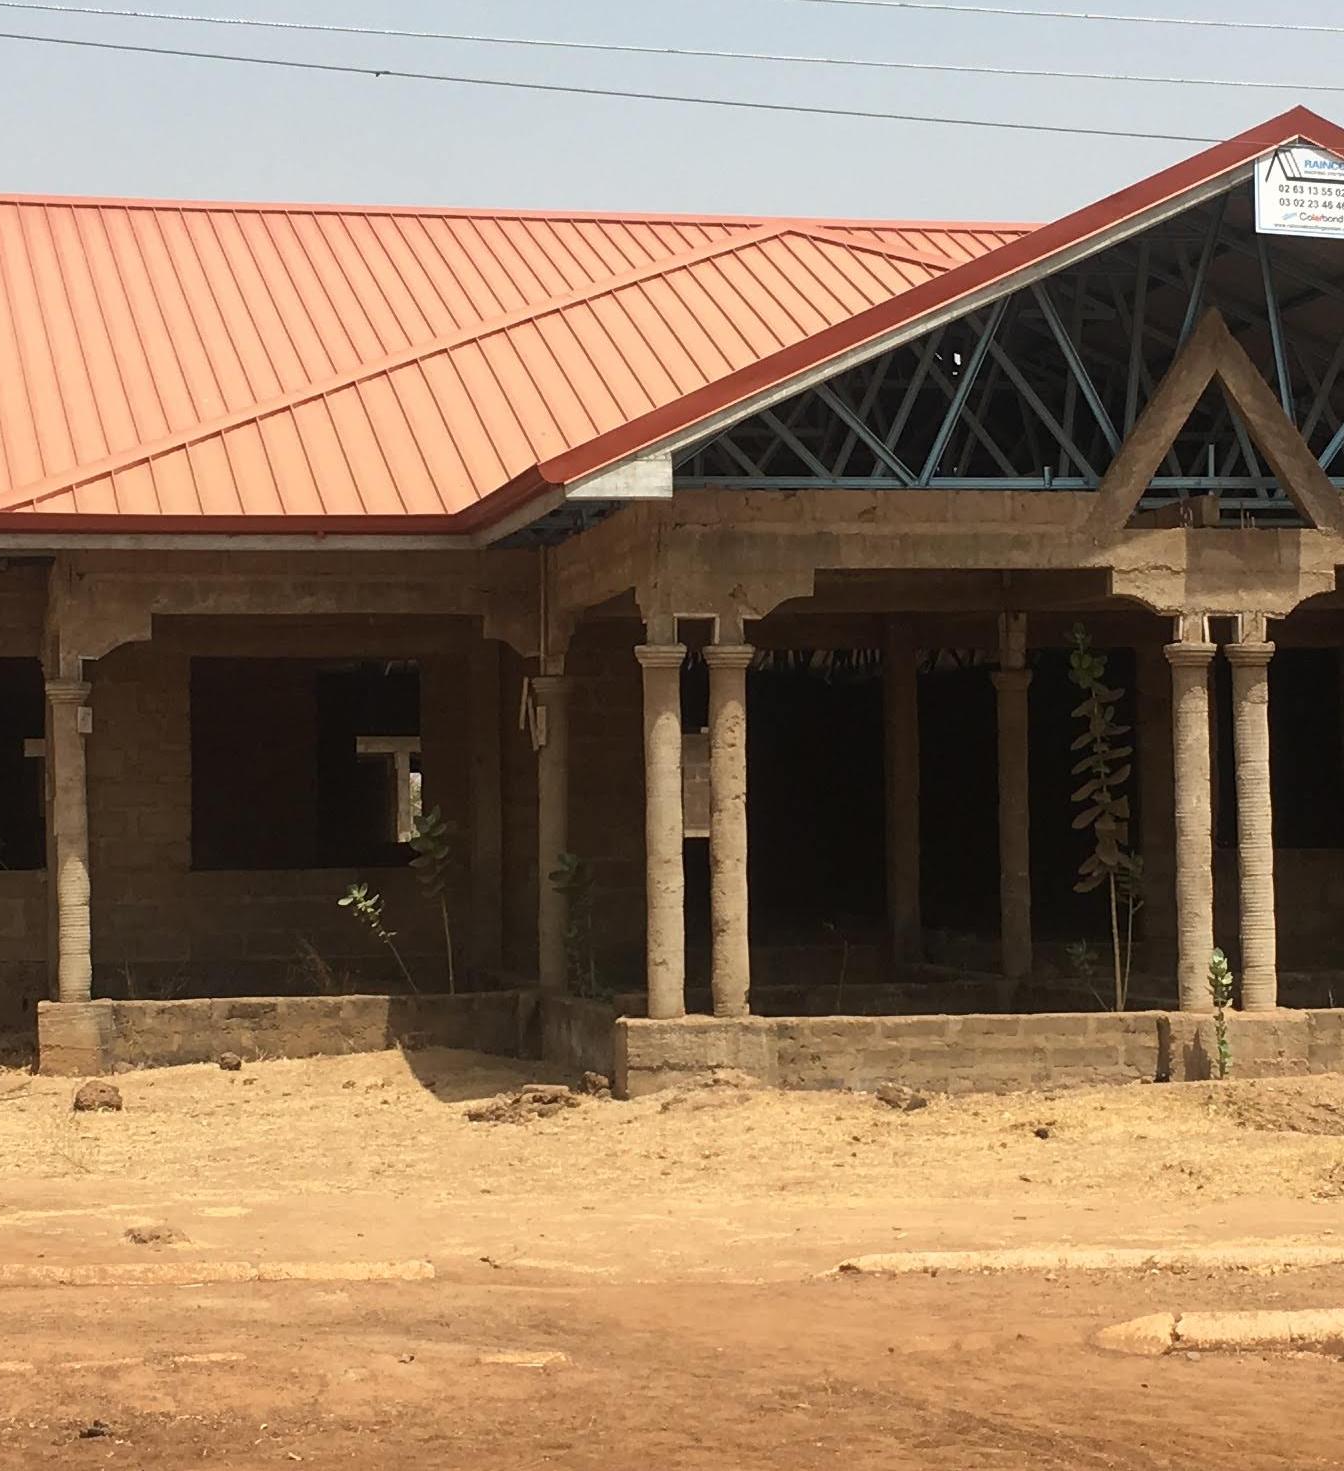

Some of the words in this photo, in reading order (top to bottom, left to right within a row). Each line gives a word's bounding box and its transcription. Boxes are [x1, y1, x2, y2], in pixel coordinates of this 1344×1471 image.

[1278, 184, 1290, 193] 02
[1279, 198, 1290, 207] 03
[1293, 199, 1305, 208] 02
[1307, 199, 1319, 208] 23
